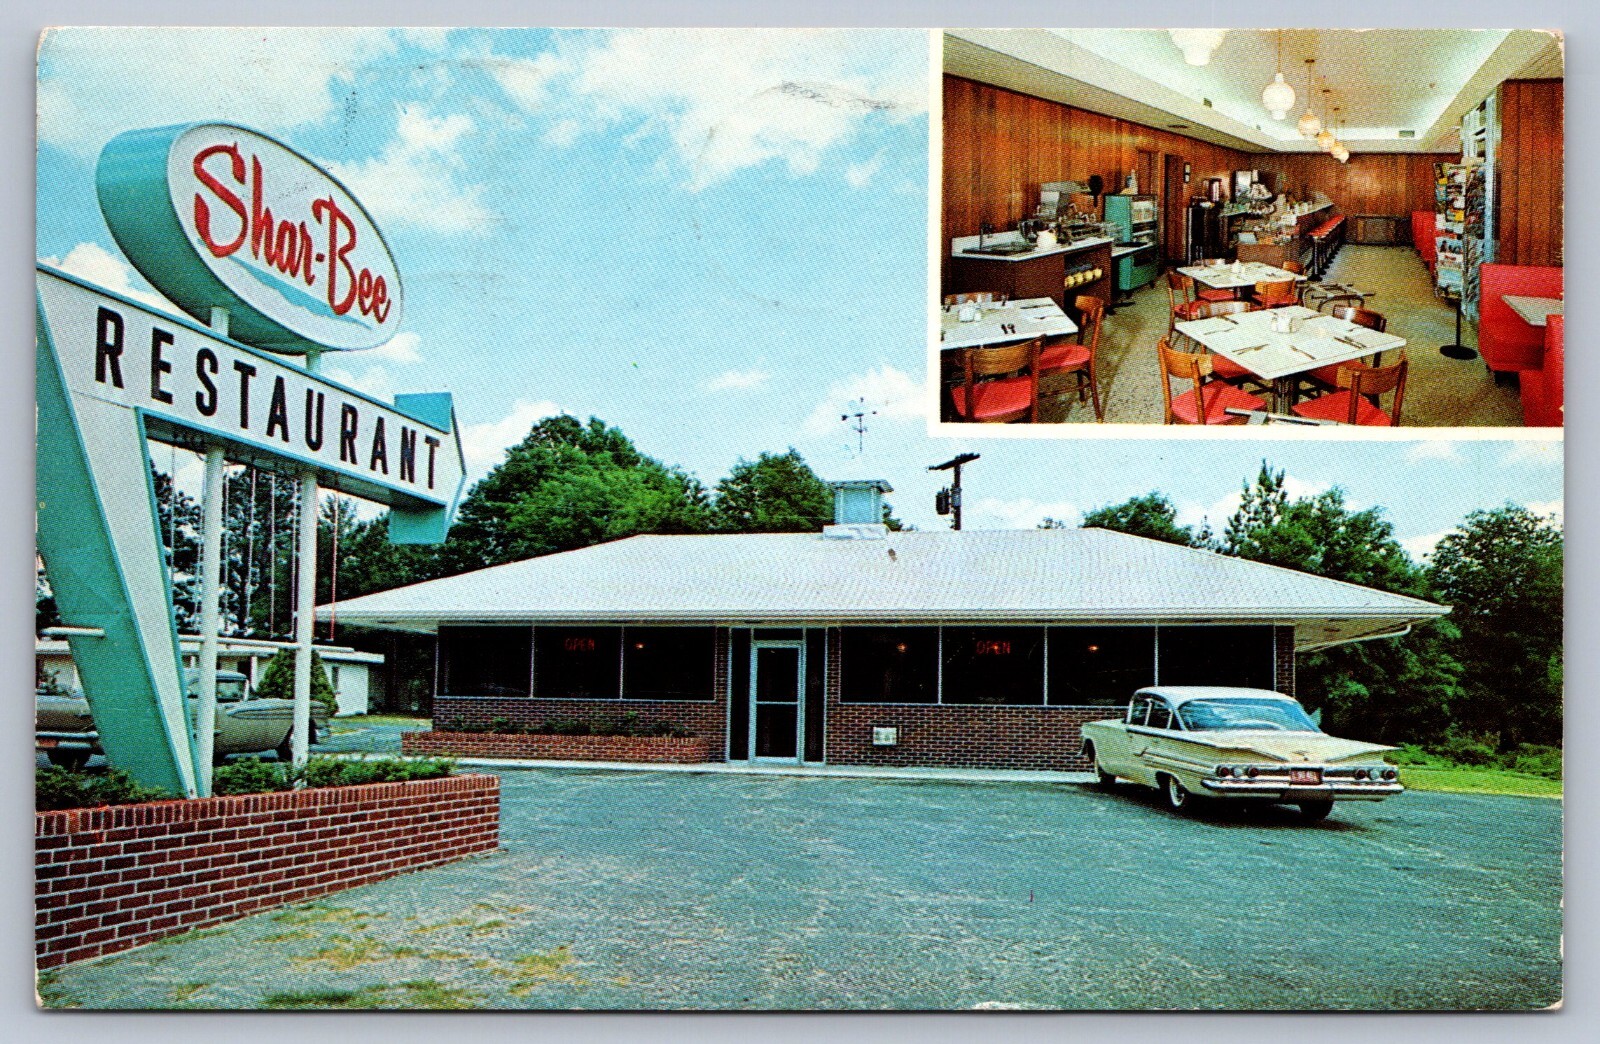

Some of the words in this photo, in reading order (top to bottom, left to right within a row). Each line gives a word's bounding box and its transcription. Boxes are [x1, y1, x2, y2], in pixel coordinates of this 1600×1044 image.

[193, 142, 391, 324] Shar-Bee
[94, 306, 441, 490] RESTAURANT
[564, 638, 596, 652] OPEN
[975, 640, 1011, 655] OPEN
